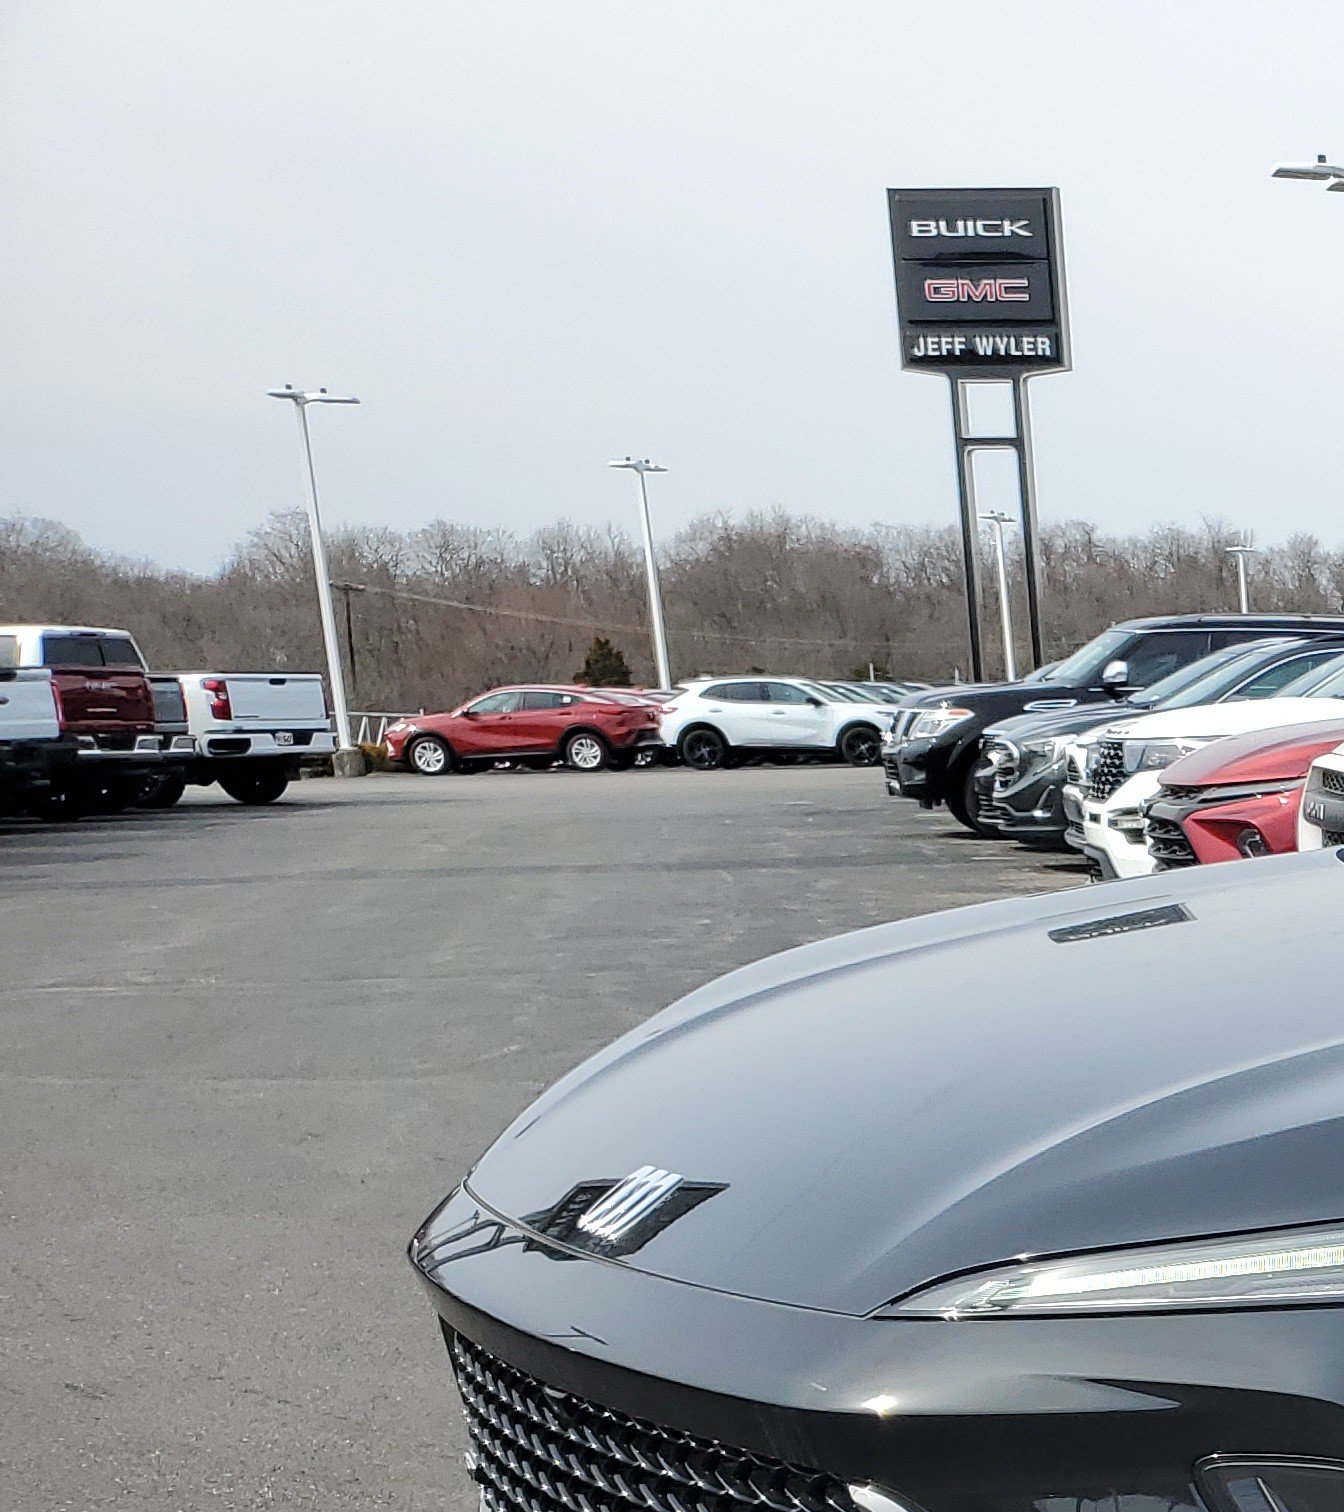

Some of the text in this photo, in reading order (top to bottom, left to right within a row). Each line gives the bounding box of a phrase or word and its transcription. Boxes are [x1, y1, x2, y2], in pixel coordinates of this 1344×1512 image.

[910, 219, 1033, 237] BUICK
[924, 277, 1030, 302] GMC
[913, 334, 1051, 356] JEFF WYLER
